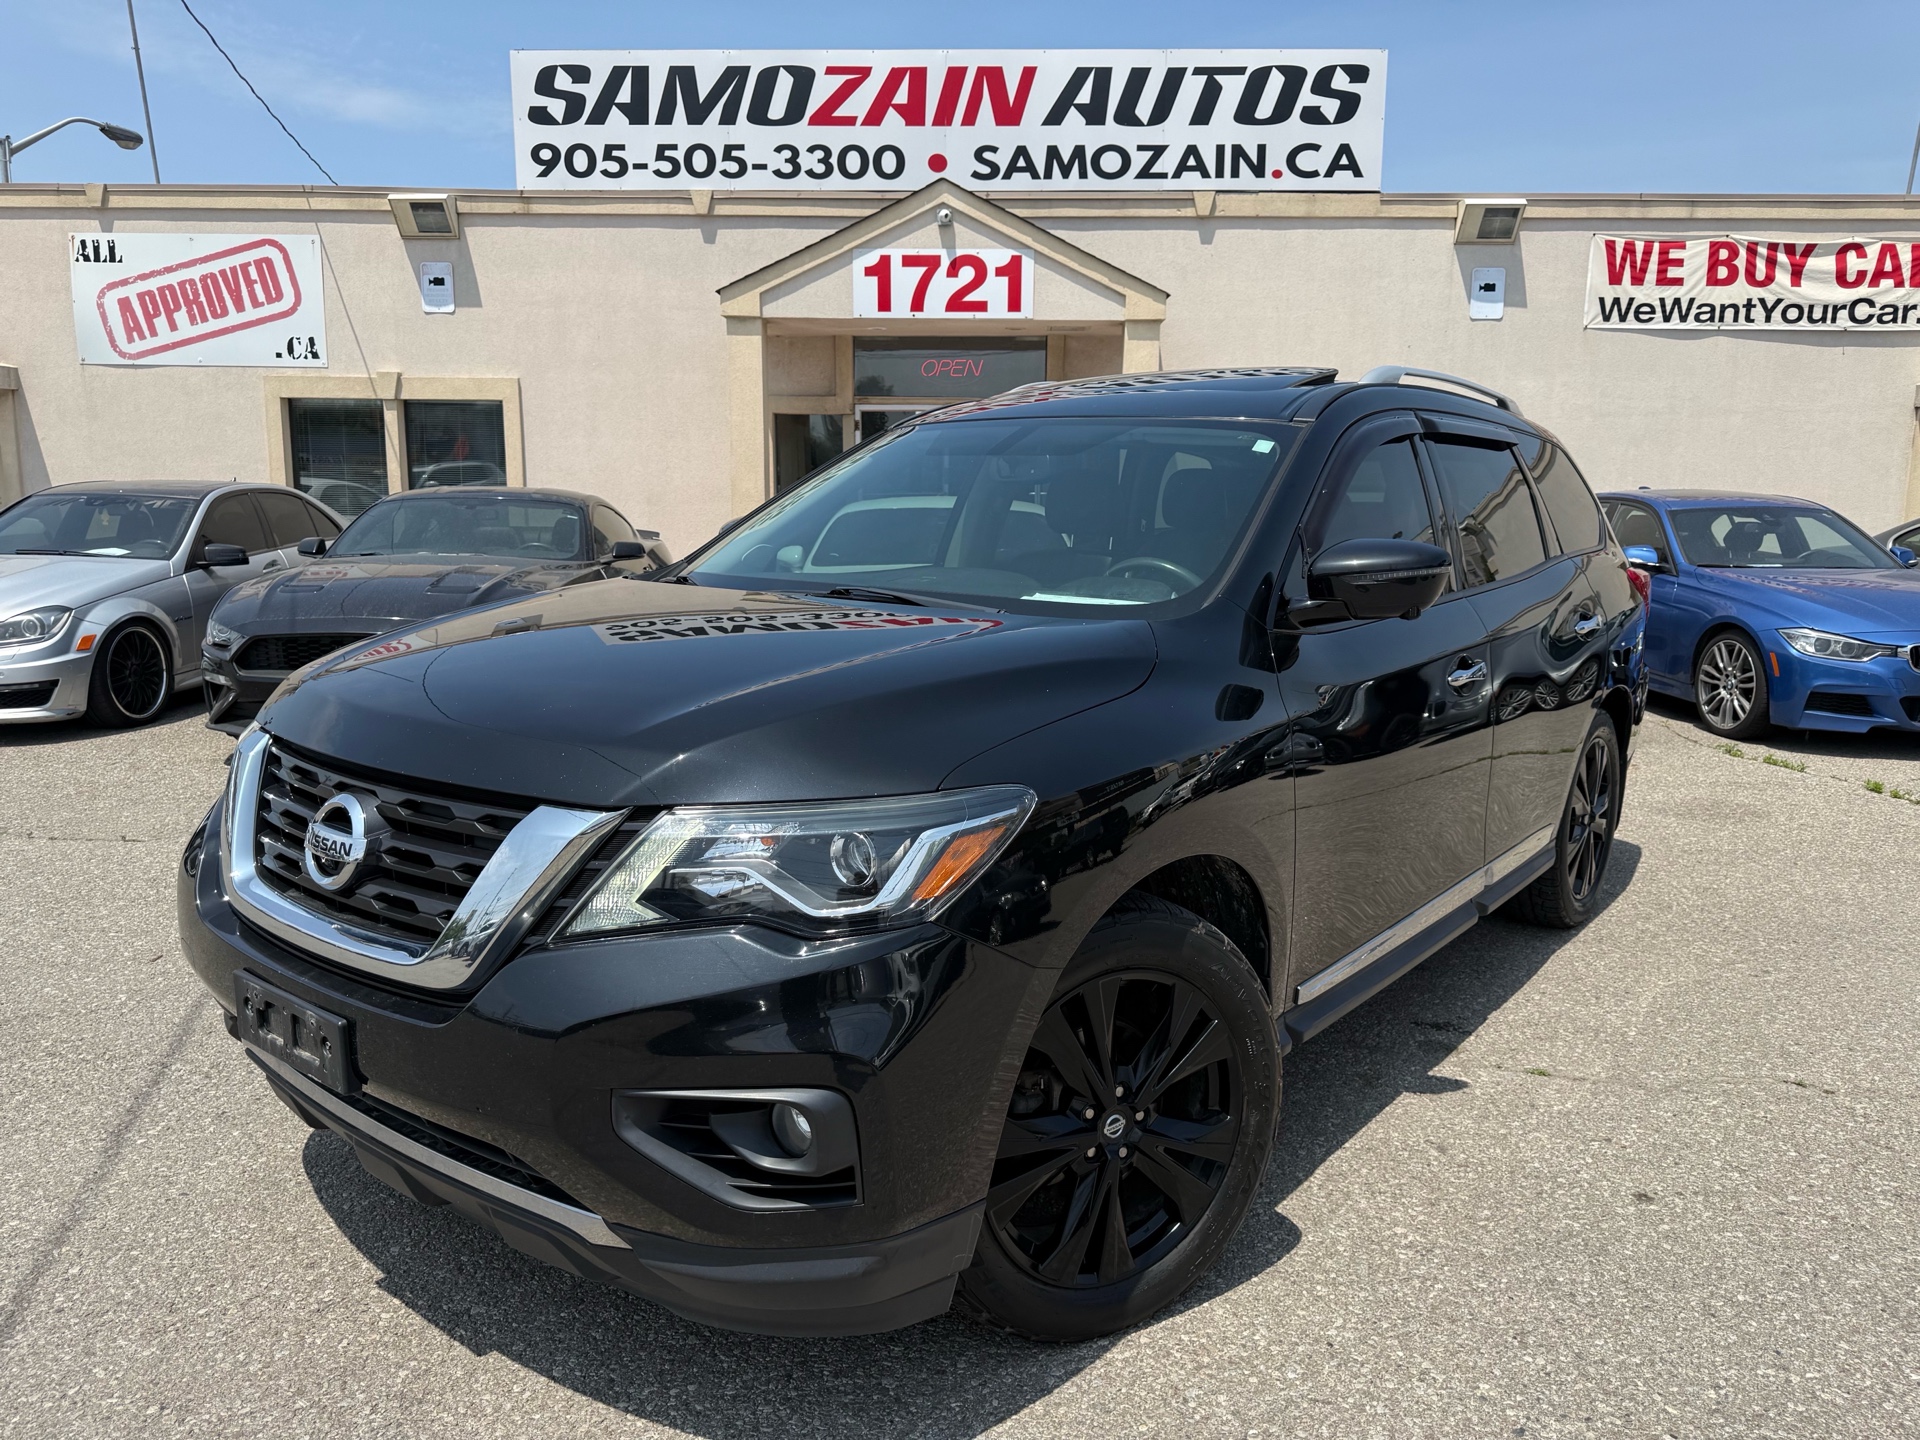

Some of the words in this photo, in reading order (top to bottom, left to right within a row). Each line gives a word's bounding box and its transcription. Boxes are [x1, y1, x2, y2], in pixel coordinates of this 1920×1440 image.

[528, 64, 1037, 126] SAMOZAIN
[1041, 64, 1370, 126] AUTOS
[530, 143, 905, 180] 905-505-3300
[970, 143, 1364, 180] SAMOZAIN.CA
[75, 239, 123, 263] ALL
[1604, 239, 1686, 286] WE
[1705, 240, 1818, 288] BUY
[117, 256, 284, 344] APPROVED
[864, 254, 1022, 312] 1721
[275, 336, 320, 360] .CA
[921, 360, 983, 376] OPEN
[306, 828, 353, 857] NISSAN
